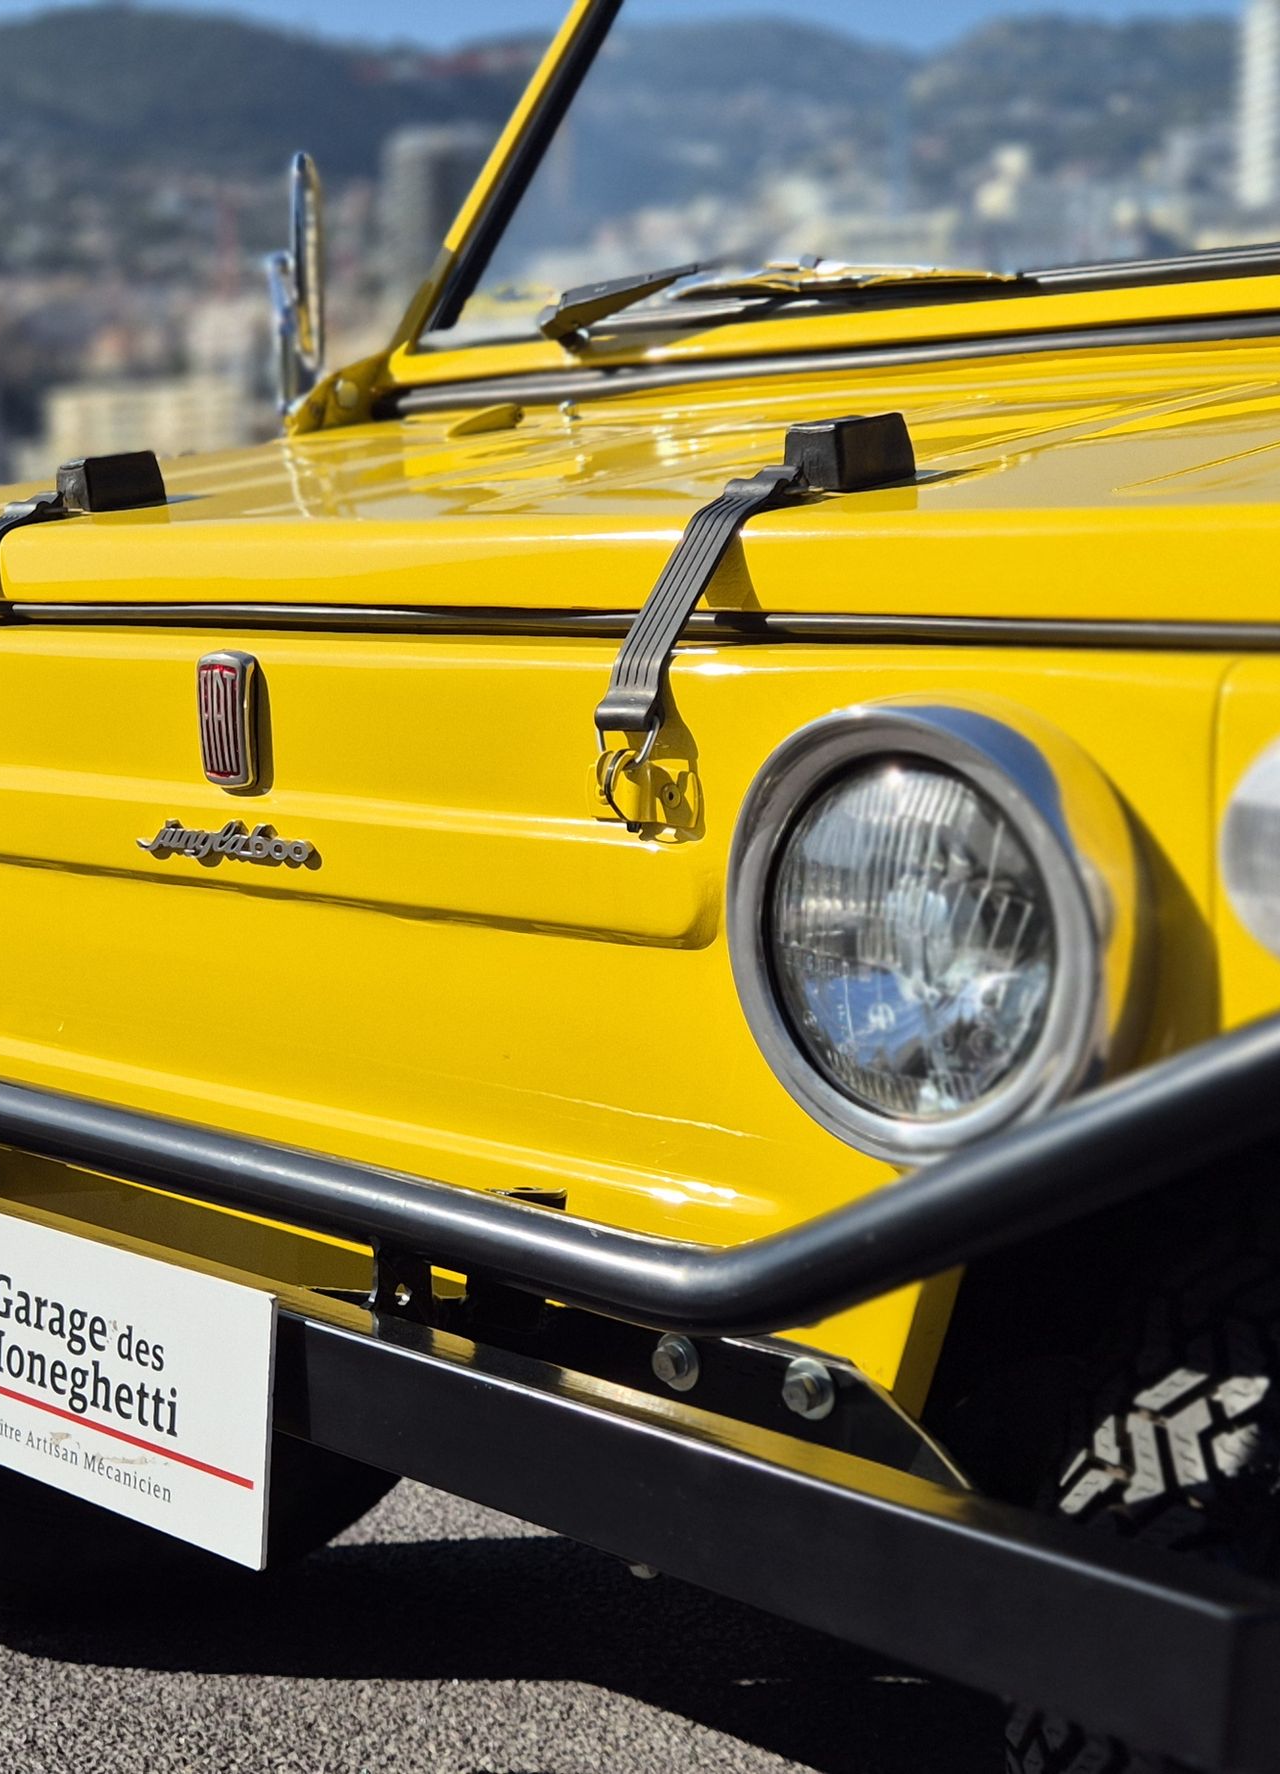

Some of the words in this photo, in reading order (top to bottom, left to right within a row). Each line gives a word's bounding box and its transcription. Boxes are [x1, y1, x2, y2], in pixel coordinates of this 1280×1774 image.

[200, 668, 237, 774] FIAT
[117, 1325, 165, 1371] des
[26, 1431, 78, 1467] Artisan
[84, 1451, 172, 1504] Mécanicien
